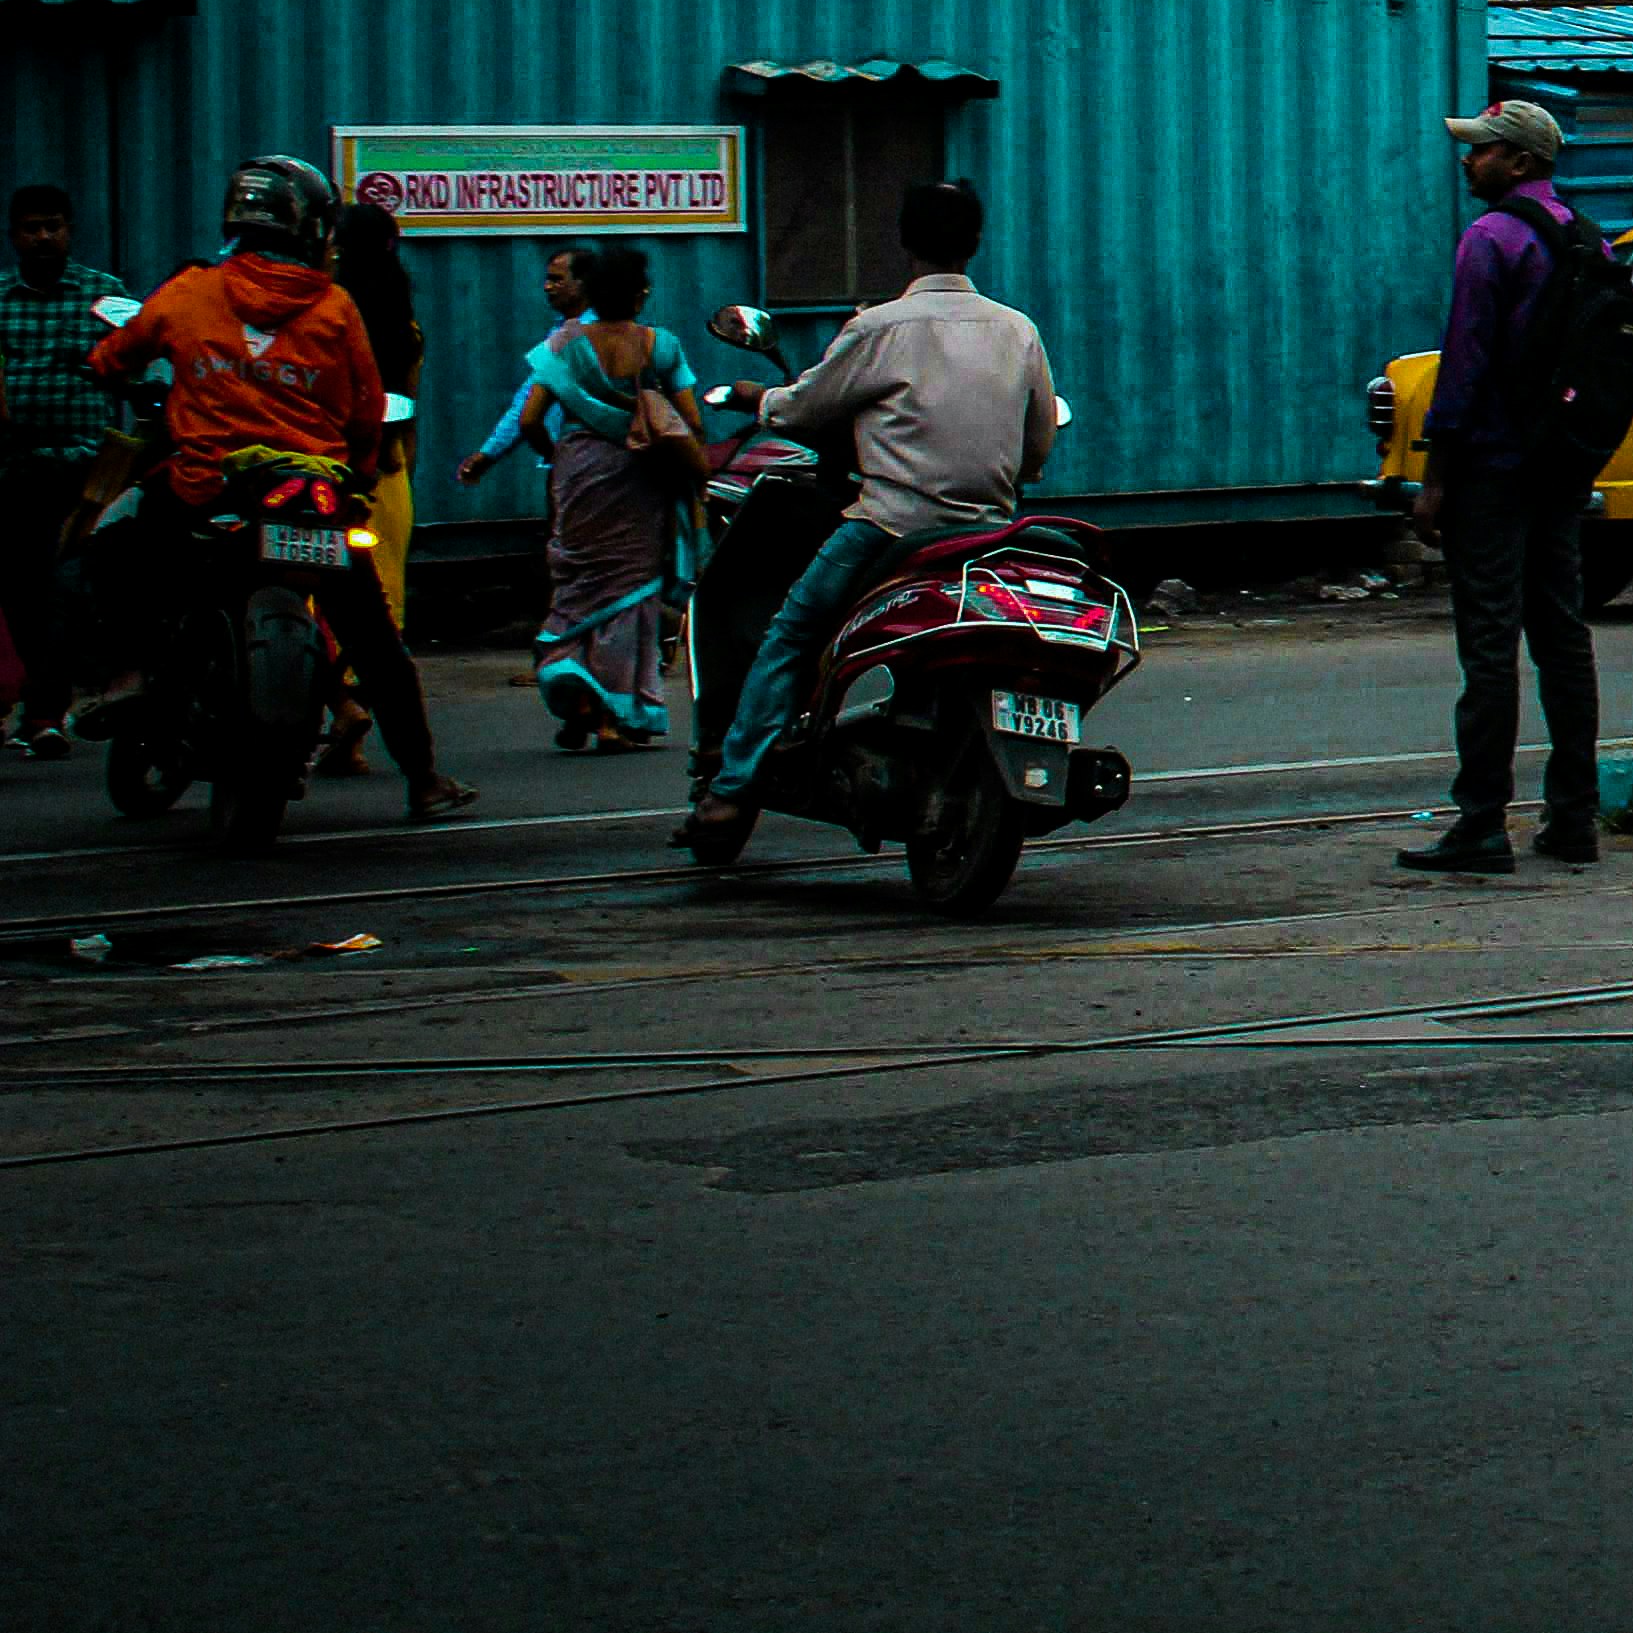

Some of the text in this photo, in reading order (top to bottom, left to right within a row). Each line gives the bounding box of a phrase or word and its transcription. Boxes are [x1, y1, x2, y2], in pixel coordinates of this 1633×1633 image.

[405, 173, 724, 209] RKD INFRASTRUCTURE PVT LTD
[194, 355, 321, 392] SWIGGY
